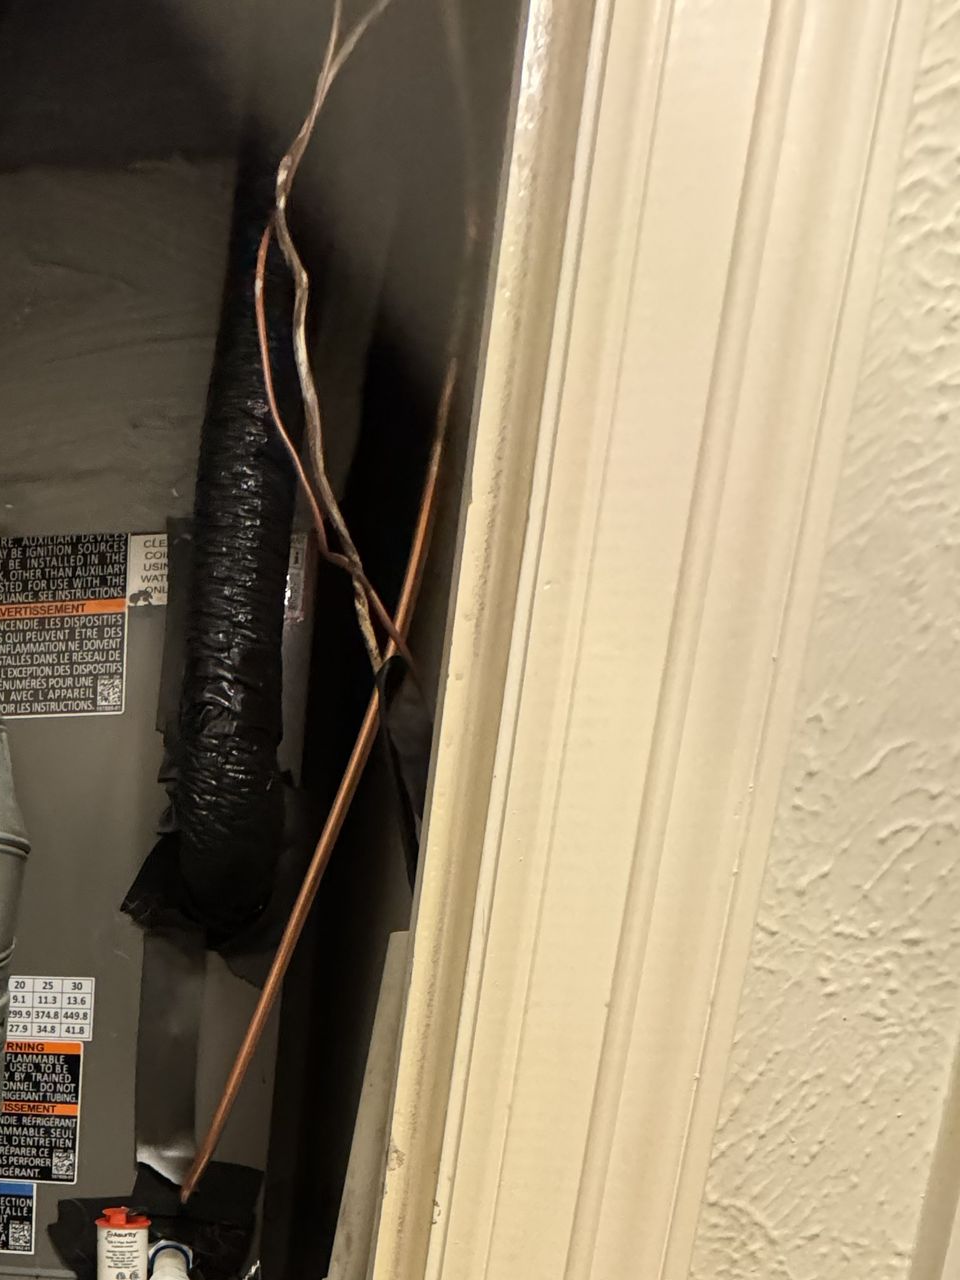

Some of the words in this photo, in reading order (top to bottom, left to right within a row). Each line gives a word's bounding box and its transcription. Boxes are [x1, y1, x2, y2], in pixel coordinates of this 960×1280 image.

[21, 535, 78, 546] AUXILIARY
[10, 548, 23, 559] BE
[26, 545, 72, 558] IGNITION
[77, 541, 126, 554] SOURCES
[8, 559, 21, 570] BE
[26, 555, 84, 568] INSTALLED
[87, 554, 99, 565] IN
[106, 552, 126, 563] THE
[9, 569, 42, 581] OTHER
[44, 567, 72, 579] THAN
[75, 564, 126, 576] AUXILIARY
[28, 579, 47, 591] FOR
[49, 578, 69, 590] USE
[72, 576, 100, 589] WITH
[106, 575, 125, 586] THE
[38, 590, 54, 602] SEE
[45, 617, 61, 629] LES
[63, 614, 122, 628] DISPOSITIFS
[5, 632, 23, 643] QUI
[26, 629, 70, 642] PEUVENT
[103, 626, 122, 638] DES
[67, 640, 80, 651] NE
[82, 638, 121, 650] DOIVENT
[33, 653, 59, 665] DANS
[60, 652, 70, 663] LE
[72, 650, 106, 662] RÉSEAU
[109, 649, 121, 661] DE
[54, 664, 71, 676] DES
[73, 662, 122, 675] DISPOSITIFS
[48, 677, 74, 688] POUR
[75, 676, 94, 687] UNE
[9, 690, 34, 701] AVEC
[16, 702, 30, 713] LES
[31, 700, 95, 713] INSTRUCTIONS.
[14, 980, 26, 990] 20
[42, 981, 54, 990] 25
[71, 982, 83, 991] 30
[12, 994, 26, 1004] 9.1
[37, 995, 57, 1005] 11.3
[67, 996, 86, 1006] 13.6
[34, 1010, 59, 1020] 374.8
[62, 1011, 88, 1020] 449.8
[8, 1024, 28, 1033] 27.9
[36, 1025, 56, 1034] 34.8
[65, 1026, 85, 1035] 41.8
[6, 1053, 66, 1065] FLAMMABLE
[40, 1063, 53, 1073] TO
[55, 1064, 69, 1074] BE
[14, 1072, 25, 1081] BY
[31, 1072, 72, 1083] TRAINED
[40, 1082, 54, 1092] DO
[56, 1083, 76, 1093] NOT
[22, 1116, 77, 1128] RÉFRIGÉRANT
[50, 1128, 74, 1138] SEUL
[0, 1146, 37, 1157] RÉPARER
[39, 1148, 50, 1158] CE
[8, 1156, 51, 1167] PERFORER
